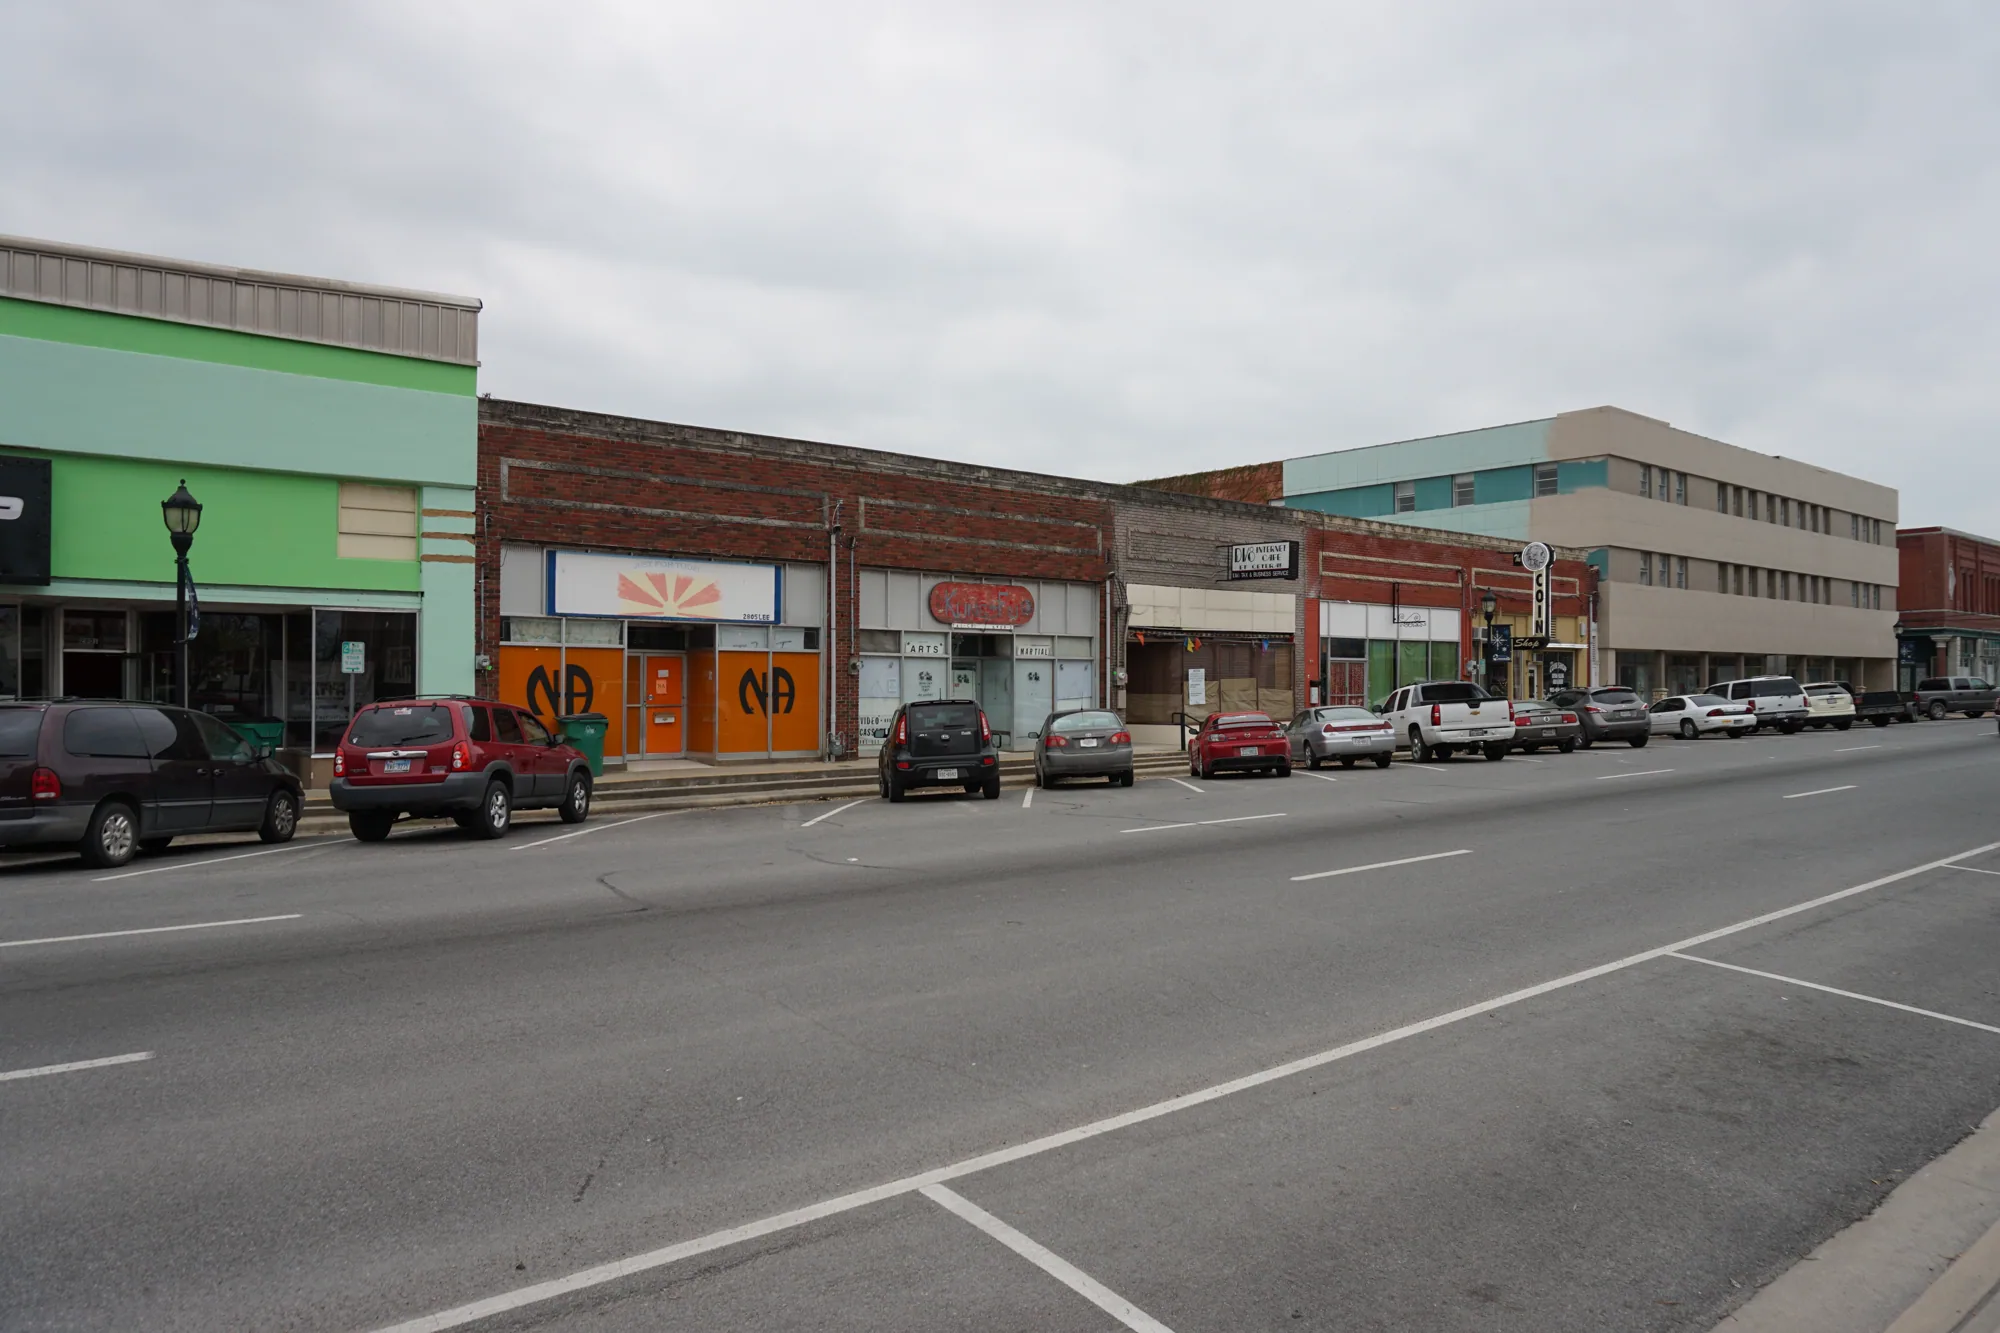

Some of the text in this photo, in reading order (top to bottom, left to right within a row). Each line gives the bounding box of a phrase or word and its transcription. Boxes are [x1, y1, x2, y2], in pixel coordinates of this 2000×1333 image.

[1256, 545, 1286, 554] INTERNET
[1536, 574, 1544, 634] COIN
[1514, 638, 1539, 648] Shop
[910, 645, 939, 654] ARTS
[1020, 647, 1048, 656] MARTIAL
[526, 664, 594, 716] NA
[738, 666, 796, 719] NA
[860, 716, 880, 725] VIDEO
